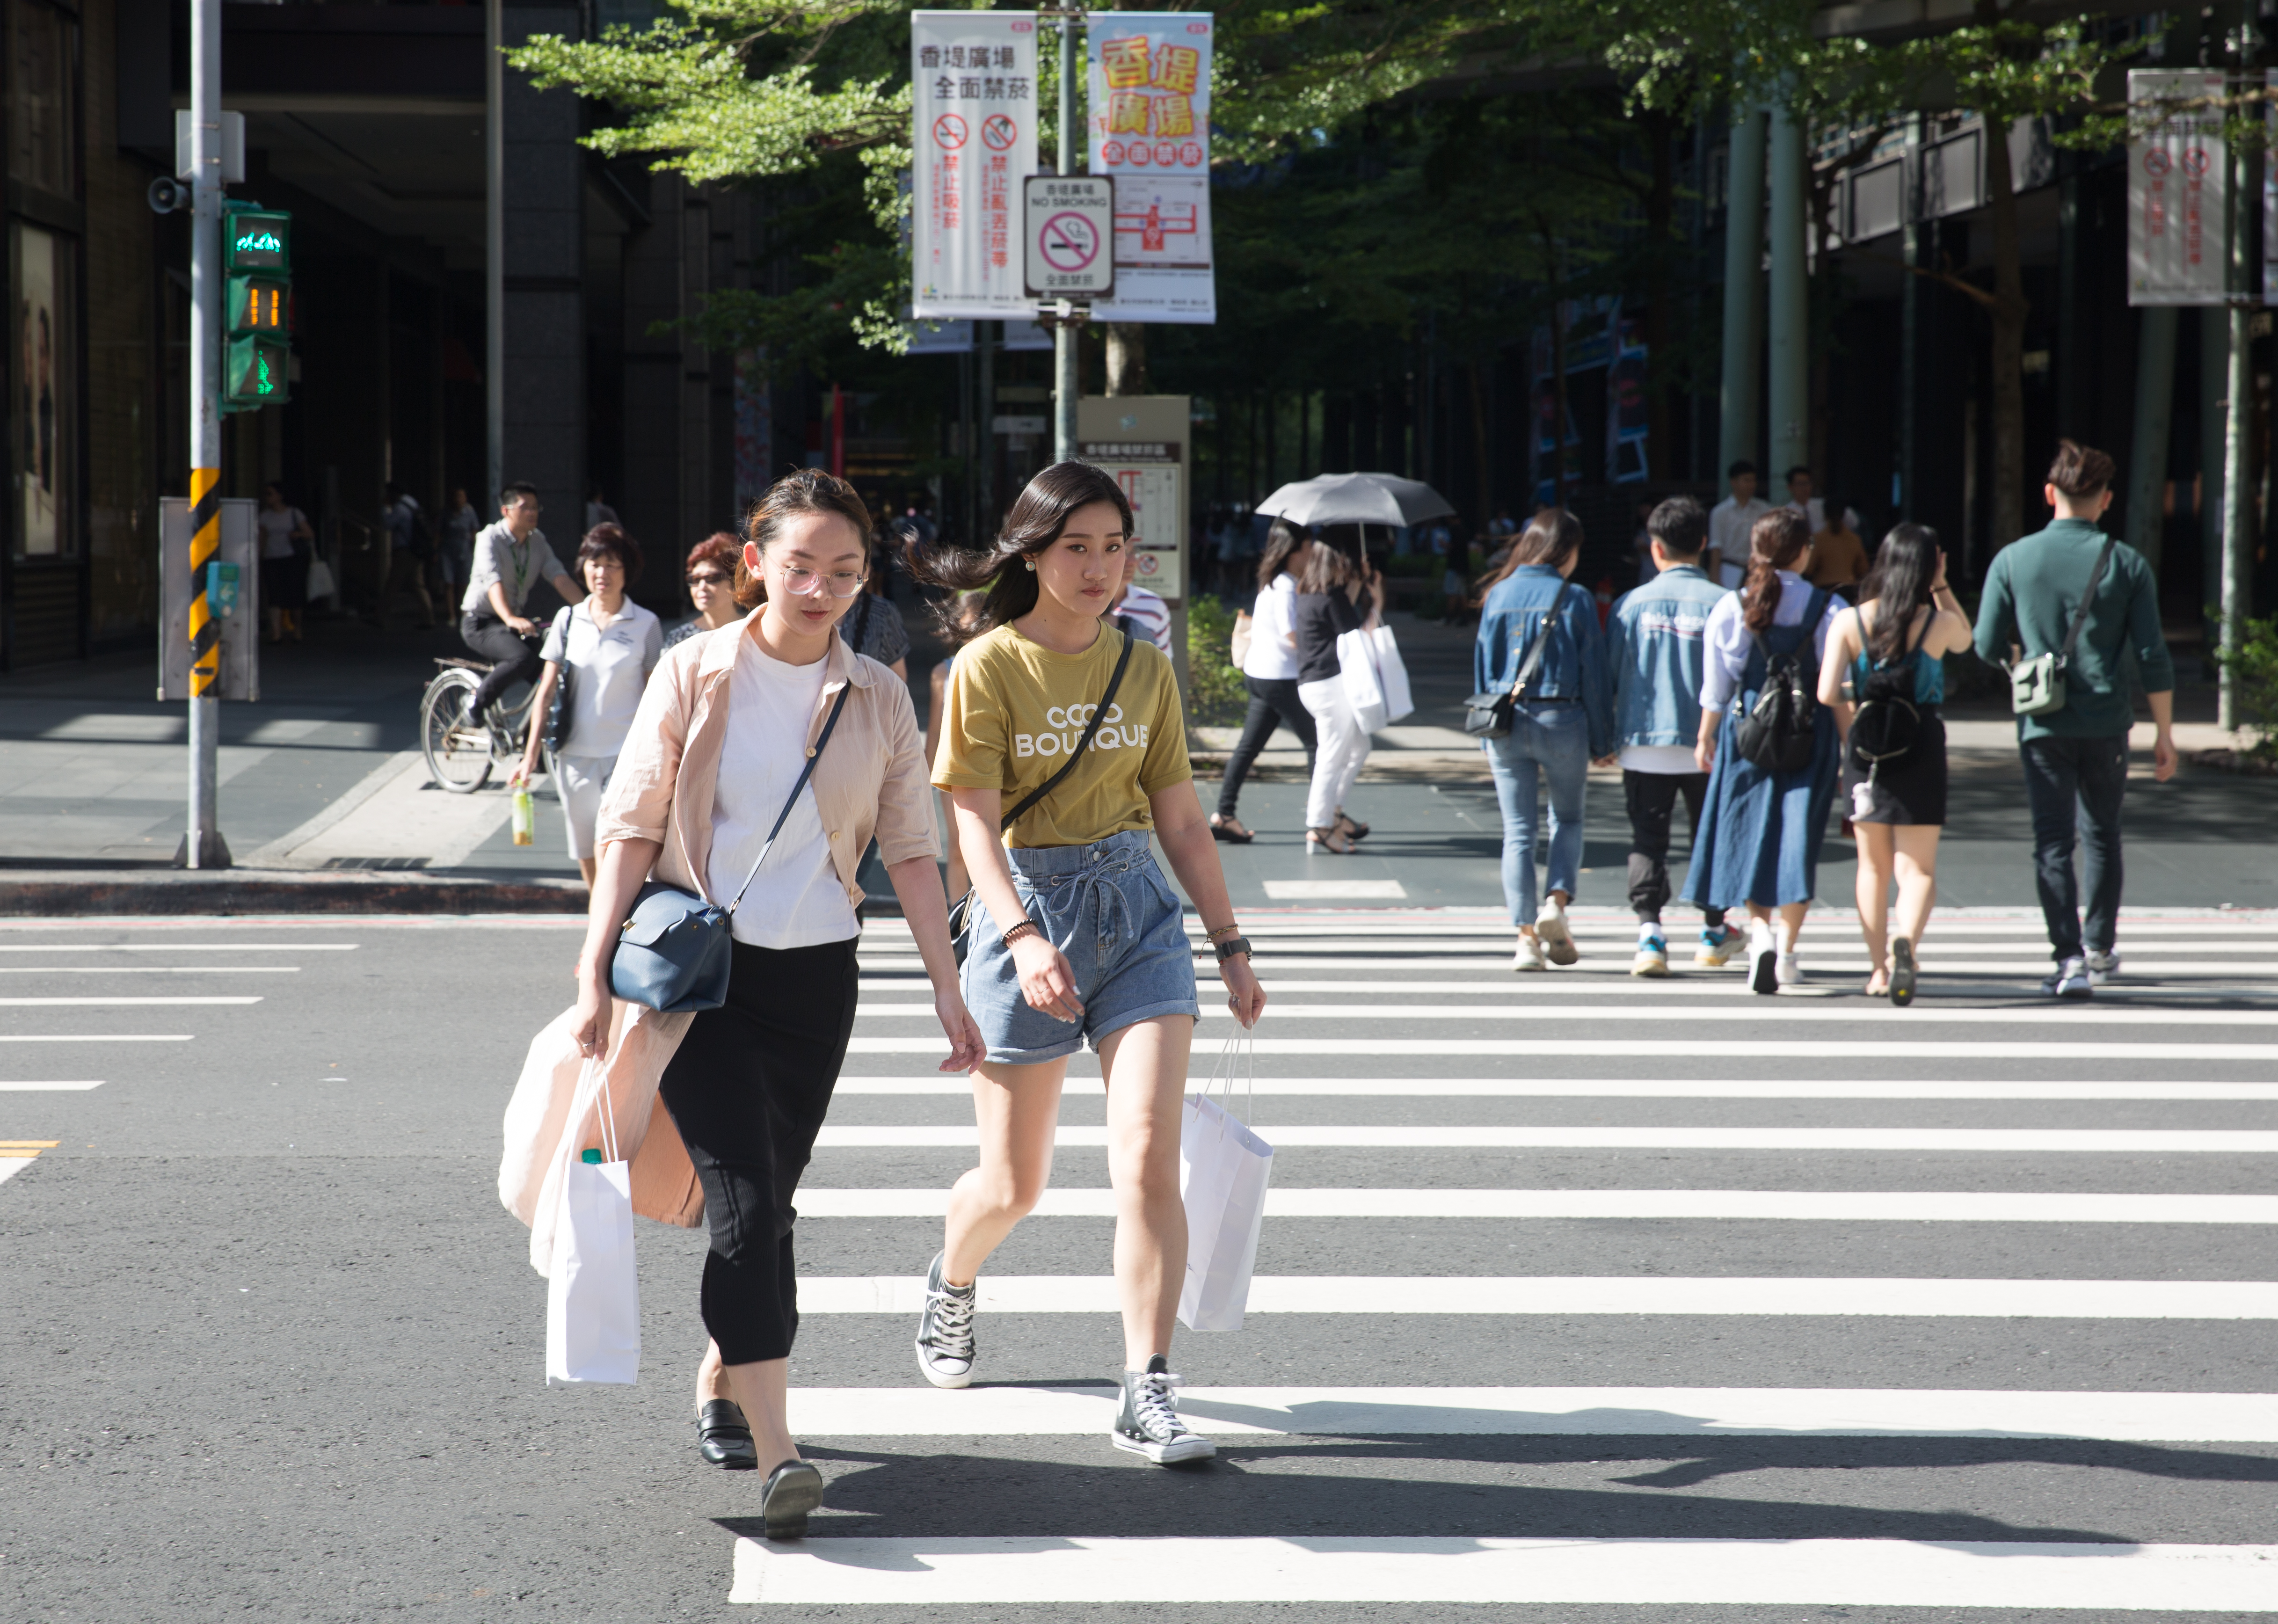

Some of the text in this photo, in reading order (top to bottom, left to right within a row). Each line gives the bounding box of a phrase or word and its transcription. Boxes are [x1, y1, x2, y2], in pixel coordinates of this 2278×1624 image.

[920, 45, 1015, 69] 香堤廣場
[1102, 35, 1200, 94] 香堤
[935, 75, 1030, 100] 全面禁菸
[1108, 92, 1195, 138] 廣場
[1103, 142, 1202, 167] 全面禁菸
[943, 154, 960, 229] 禁止吸菸
[1046, 182, 1094, 195] 香堤廣場
[1031, 197, 1107, 208] NO SMOKING
[1046, 274, 1093, 286] 全面禁菸
[251, 289, 278, 326] 11
